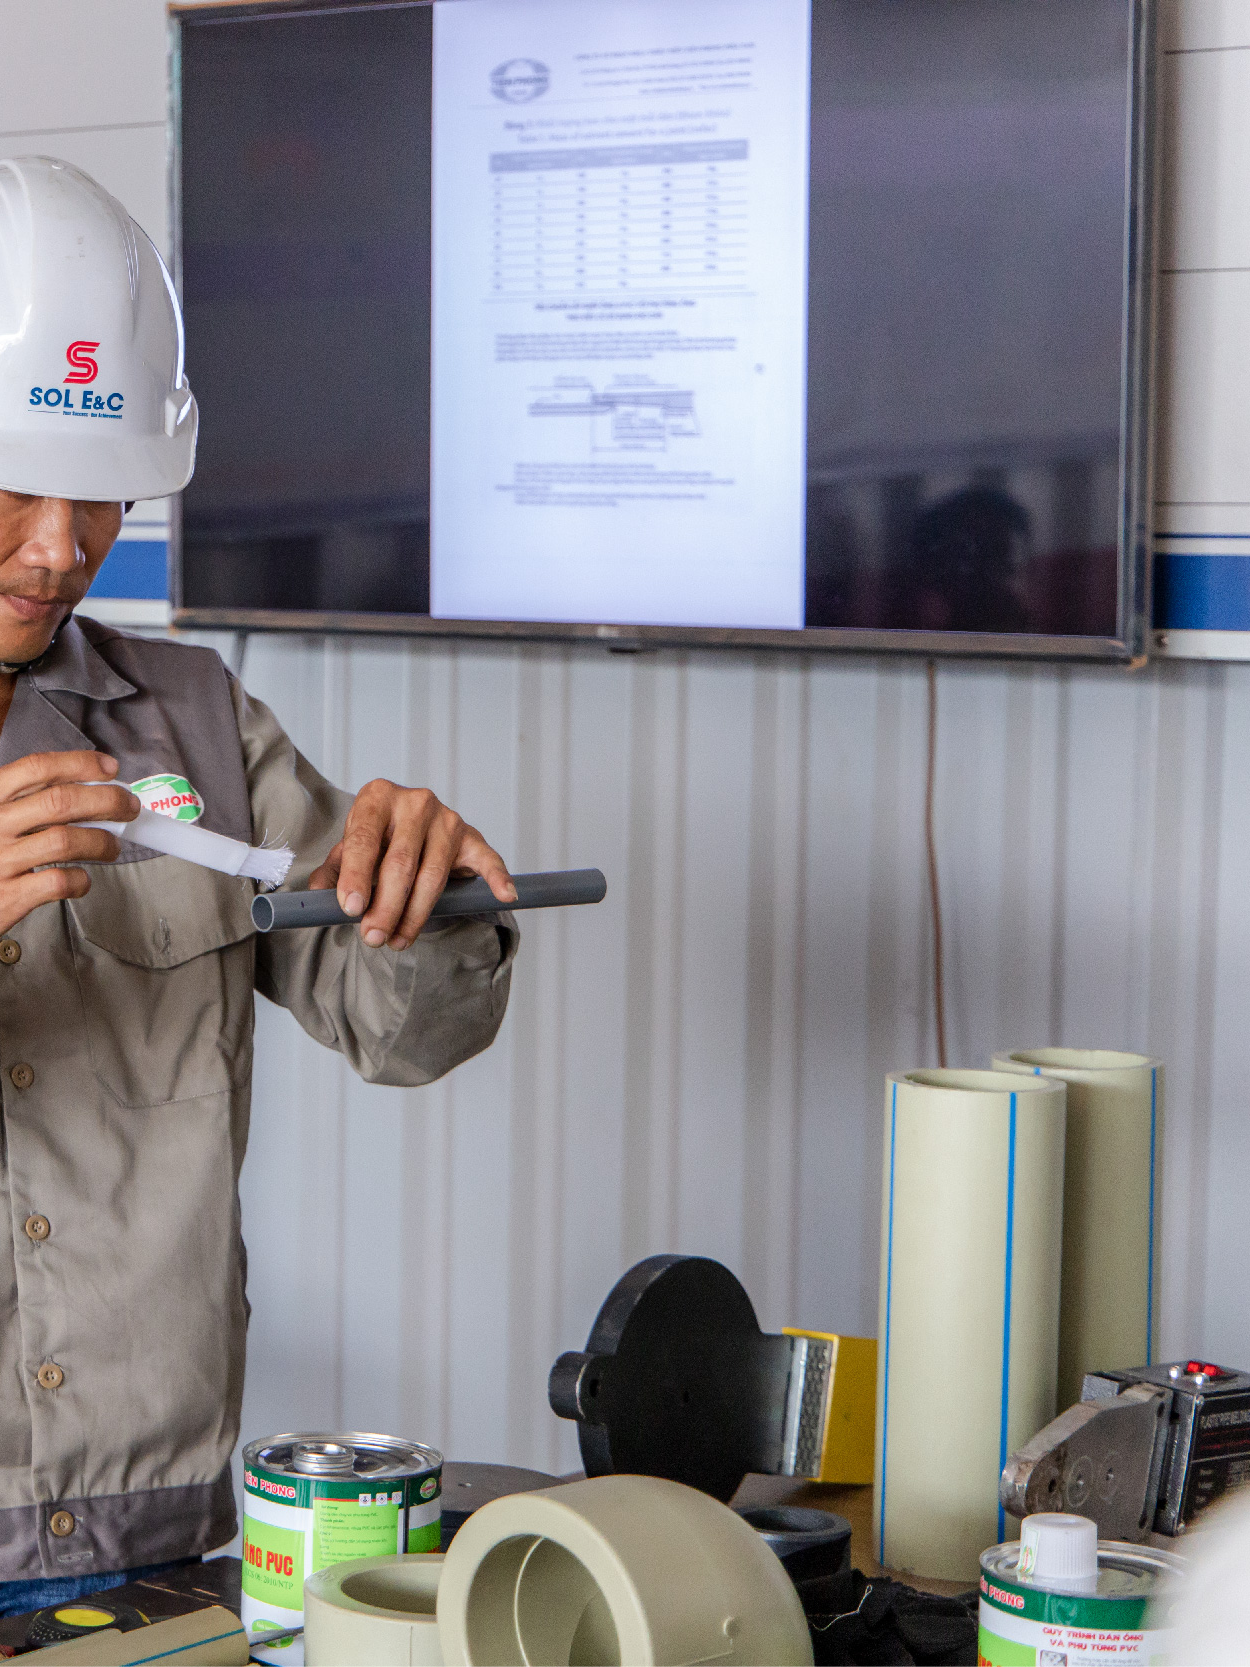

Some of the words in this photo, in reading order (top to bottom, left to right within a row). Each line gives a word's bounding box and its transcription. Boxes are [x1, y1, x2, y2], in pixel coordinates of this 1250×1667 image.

[28, 386, 75, 409] SOL
[81, 390, 125, 412] E&C
[260, 1478, 295, 1499] PHONG
[266, 1550, 293, 1577] PVC
[989, 1584, 1025, 1609] PHONG
[1042, 1627, 1063, 1636] QUY
